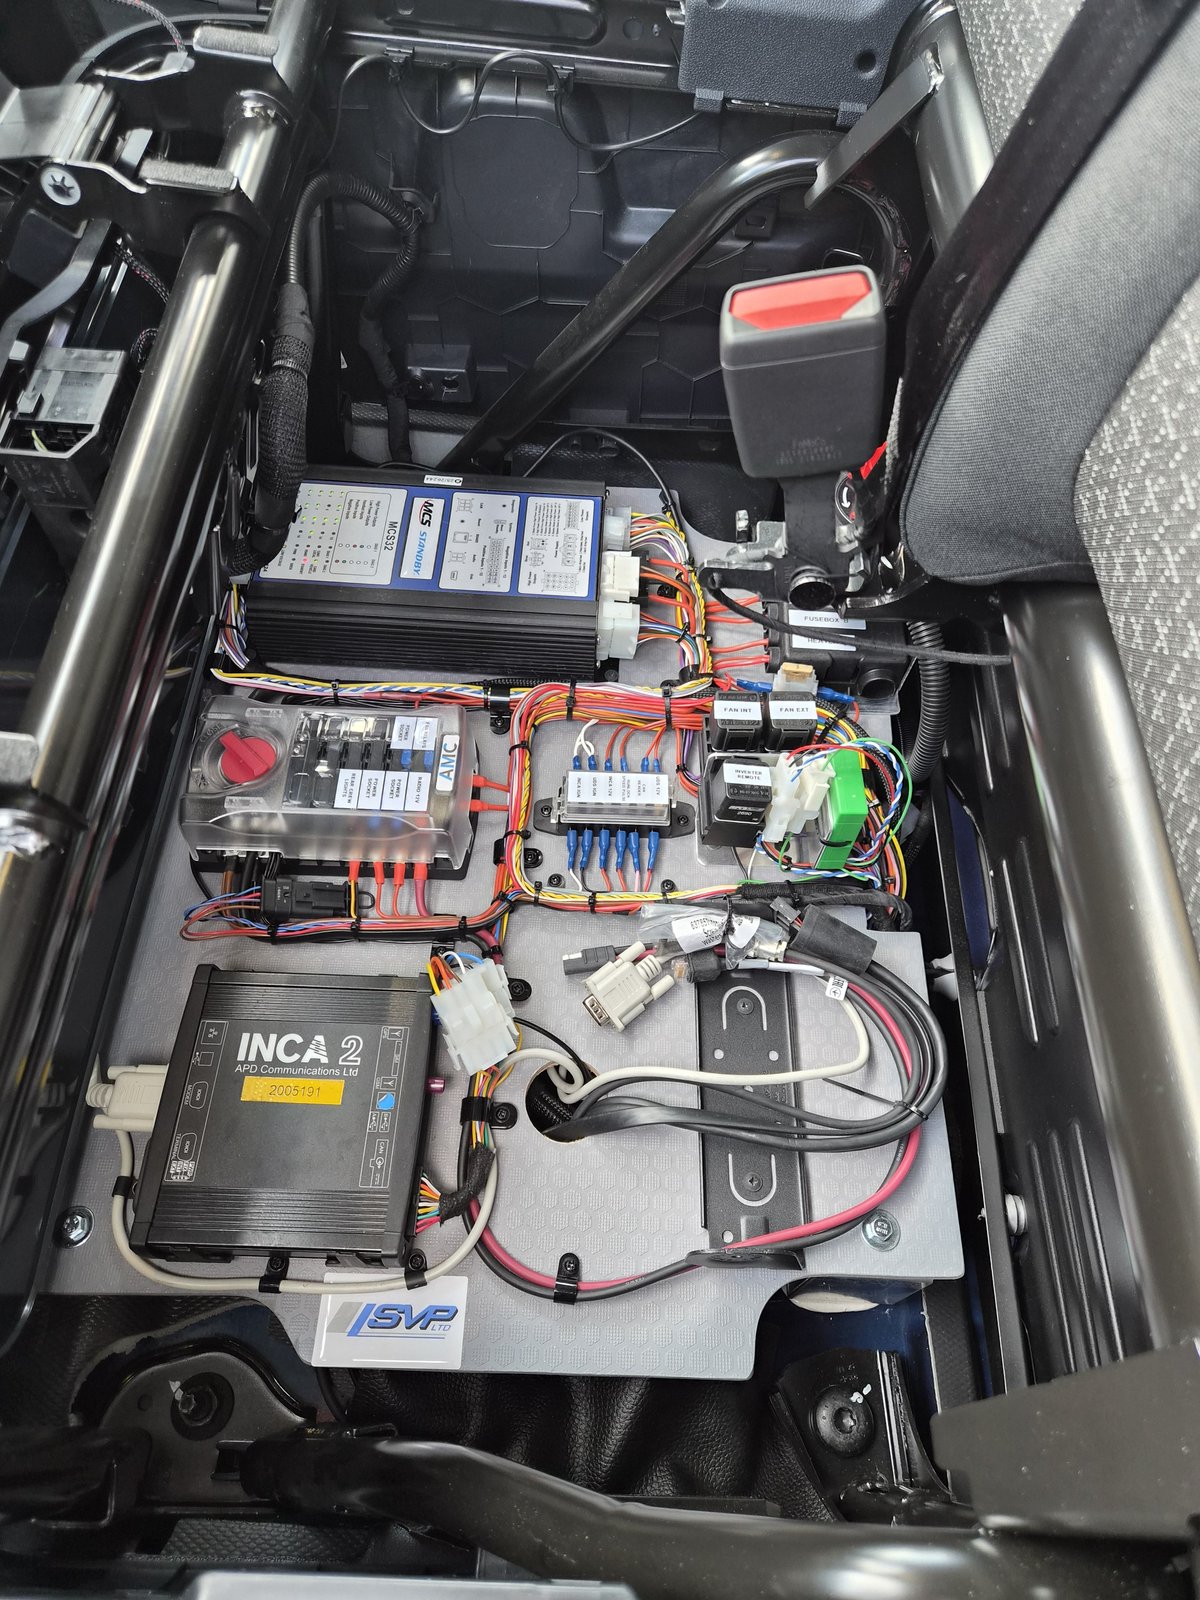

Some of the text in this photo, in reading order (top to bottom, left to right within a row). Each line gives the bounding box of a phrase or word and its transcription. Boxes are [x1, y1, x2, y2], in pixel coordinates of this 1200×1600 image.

[419, 500, 434, 527] MCS
[383, 521, 399, 551] MCS32
[412, 531, 427, 576] STANDBY
[438, 742, 458, 781] AMC
[394, 779, 402, 798] POWER
[236, 1032, 364, 1066] INCA 2
[234, 1064, 358, 1076] APD Communications Ltd
[185, 1085, 193, 1105] MODEM
[268, 1084, 321, 1097] 2005191
[172, 1133, 182, 1160] TERMINAL
[368, 1304, 458, 1330] SVP
[430, 1324, 452, 1332] LTD
